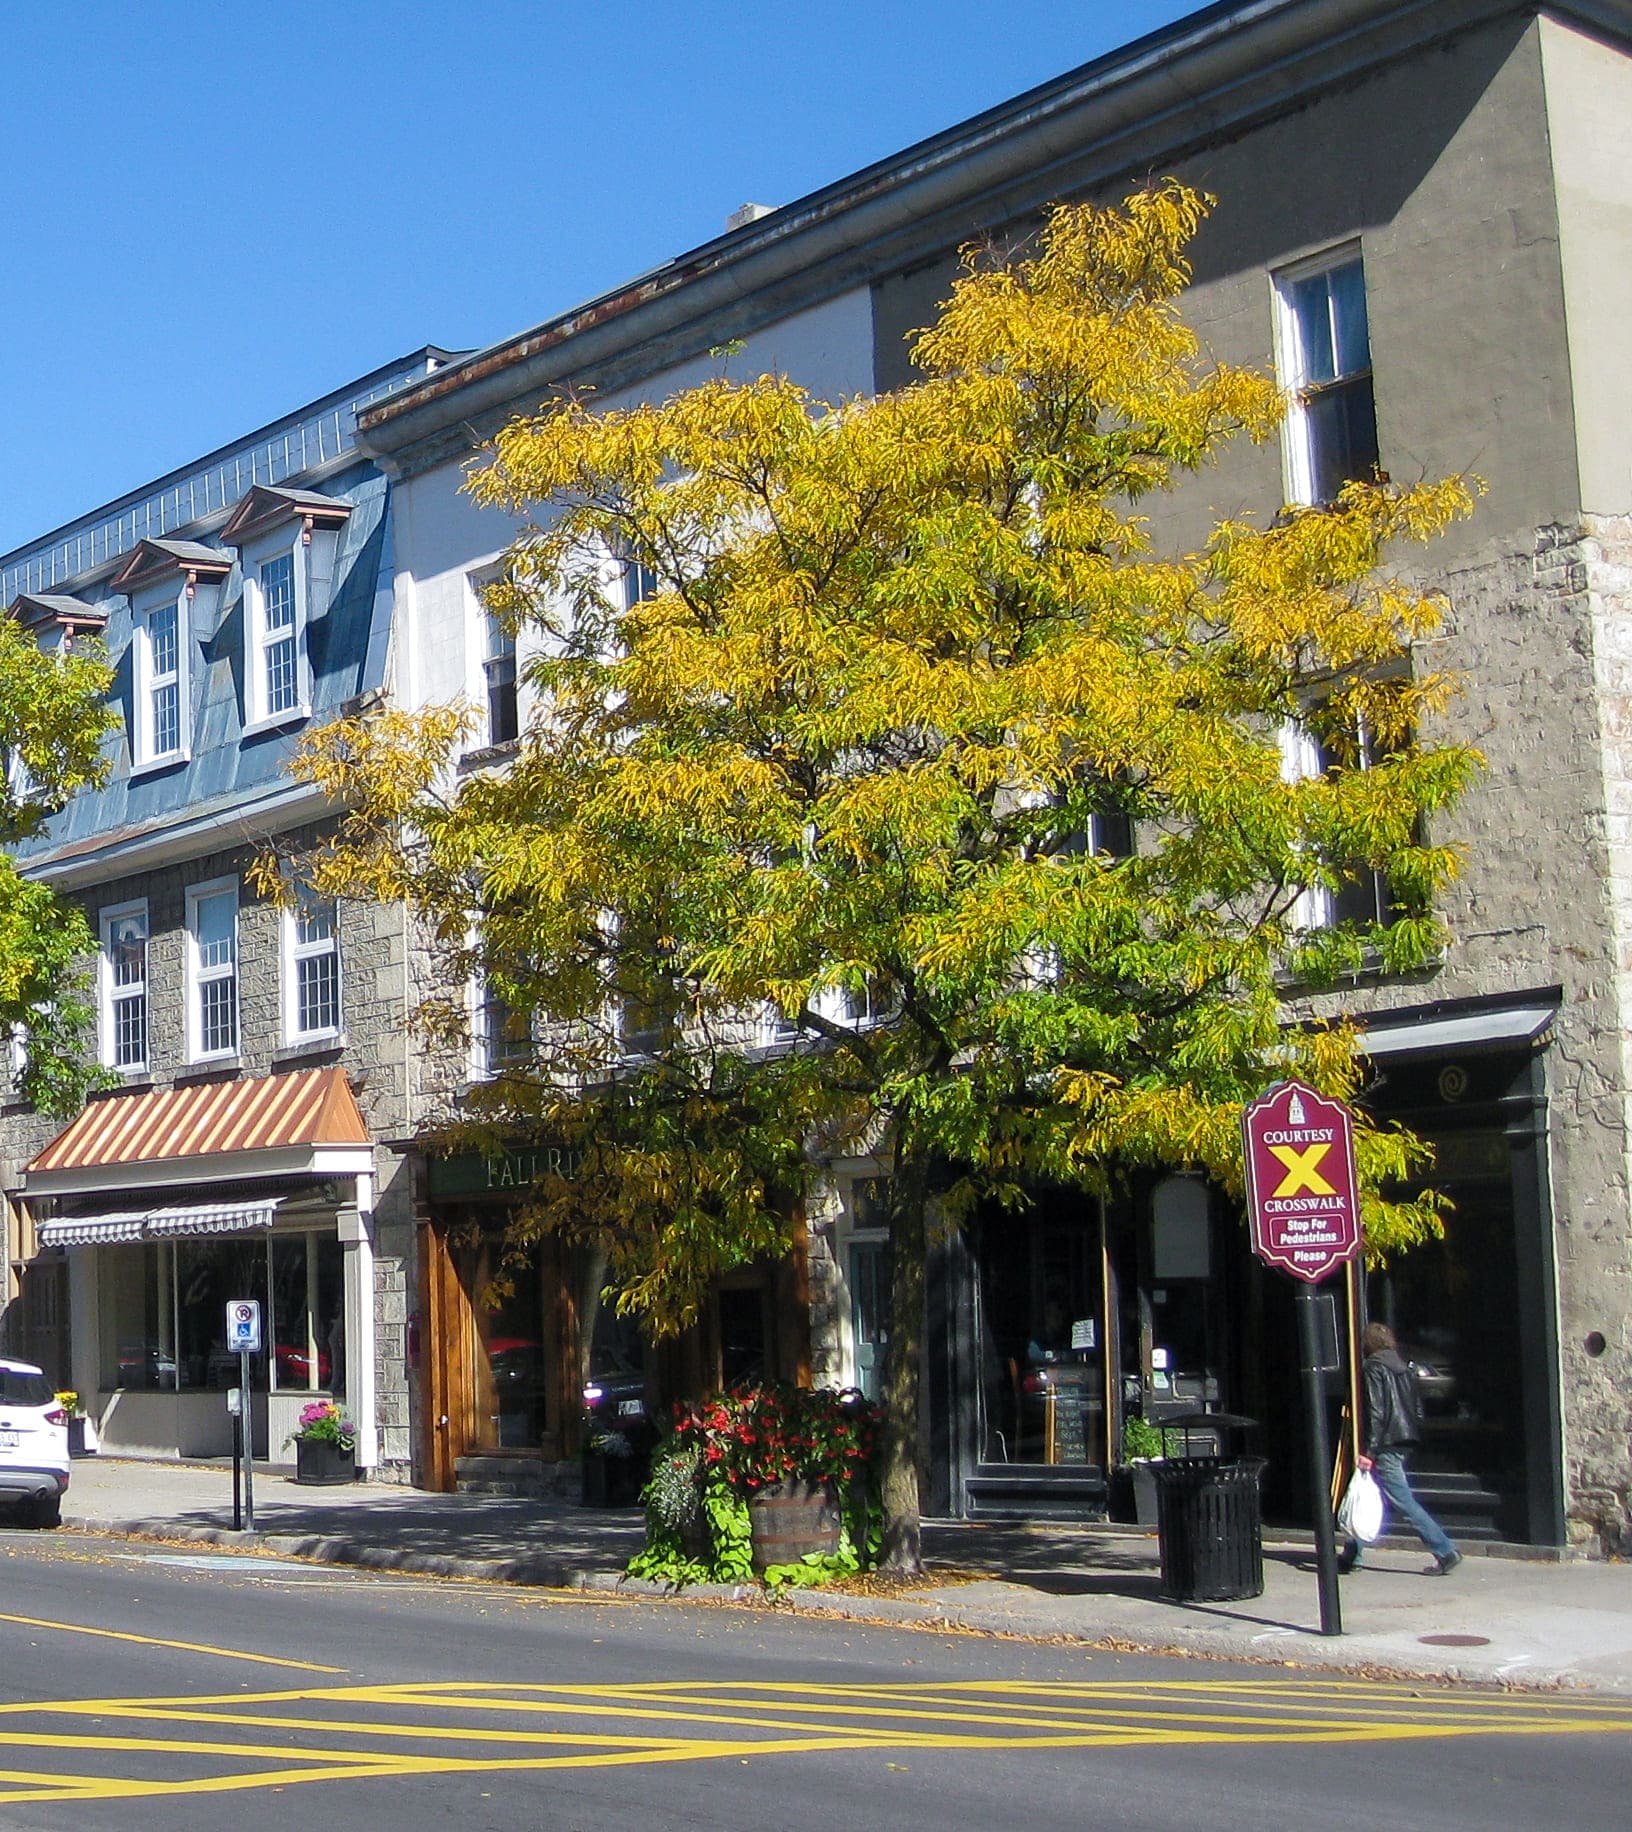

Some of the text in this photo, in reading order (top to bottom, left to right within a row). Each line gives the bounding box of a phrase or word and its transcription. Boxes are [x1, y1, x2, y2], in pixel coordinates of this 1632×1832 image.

[1263, 1128, 1334, 1144] COURTESY
[1264, 1197, 1347, 1213] CROSSWALK
[1287, 1218, 1328, 1232] Stop For
[1279, 1231, 1337, 1245] Pedestrians
[1294, 1250, 1327, 1263] Please
